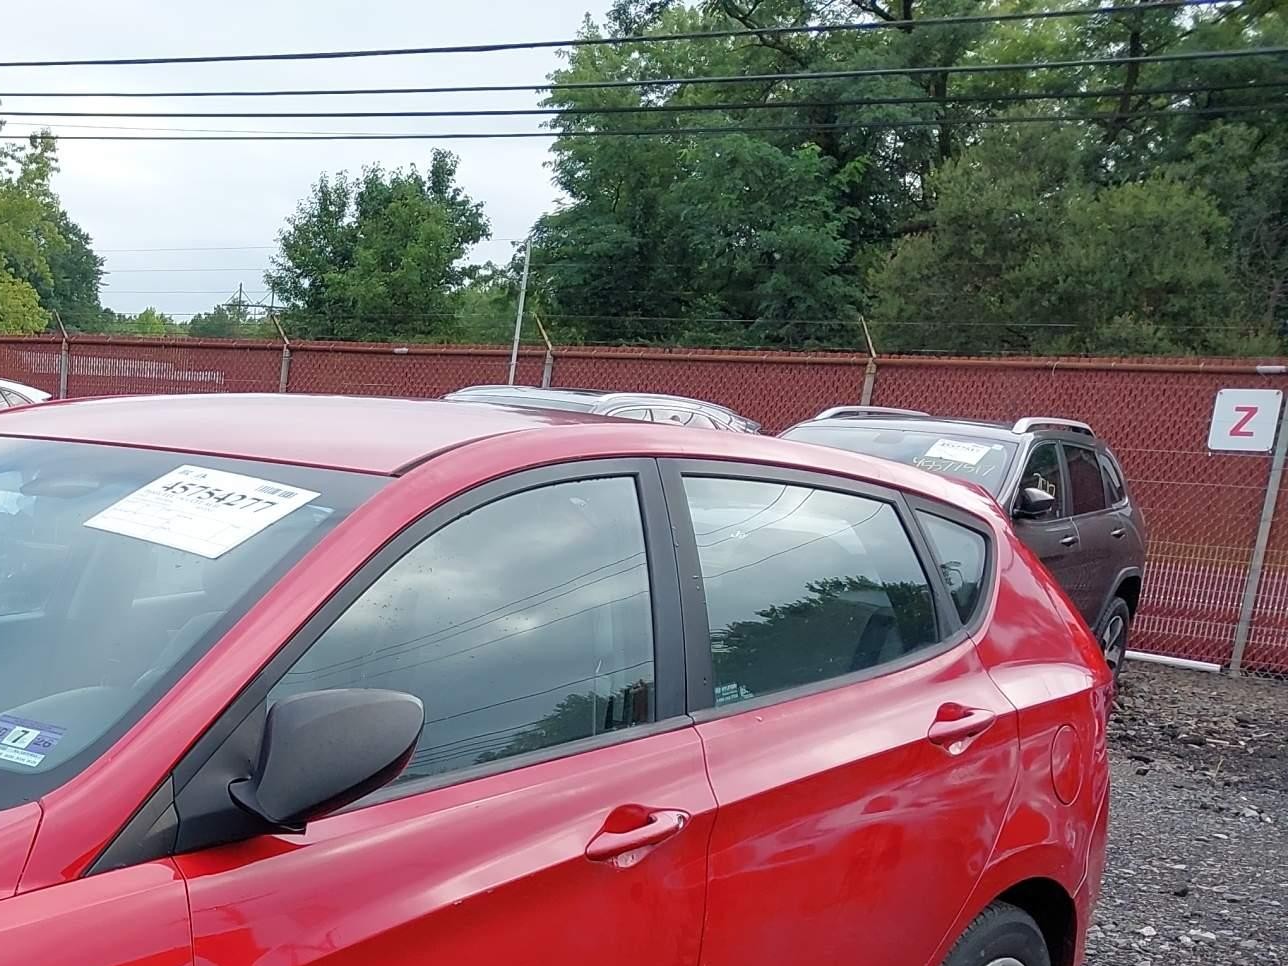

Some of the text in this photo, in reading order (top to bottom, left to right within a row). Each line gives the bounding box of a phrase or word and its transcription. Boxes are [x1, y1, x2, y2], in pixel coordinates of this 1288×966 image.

[1229, 406, 1258, 437] Z
[161, 481, 279, 512] 45754277
[12, 729, 30, 744] 7
[33, 736, 52, 748] 26
